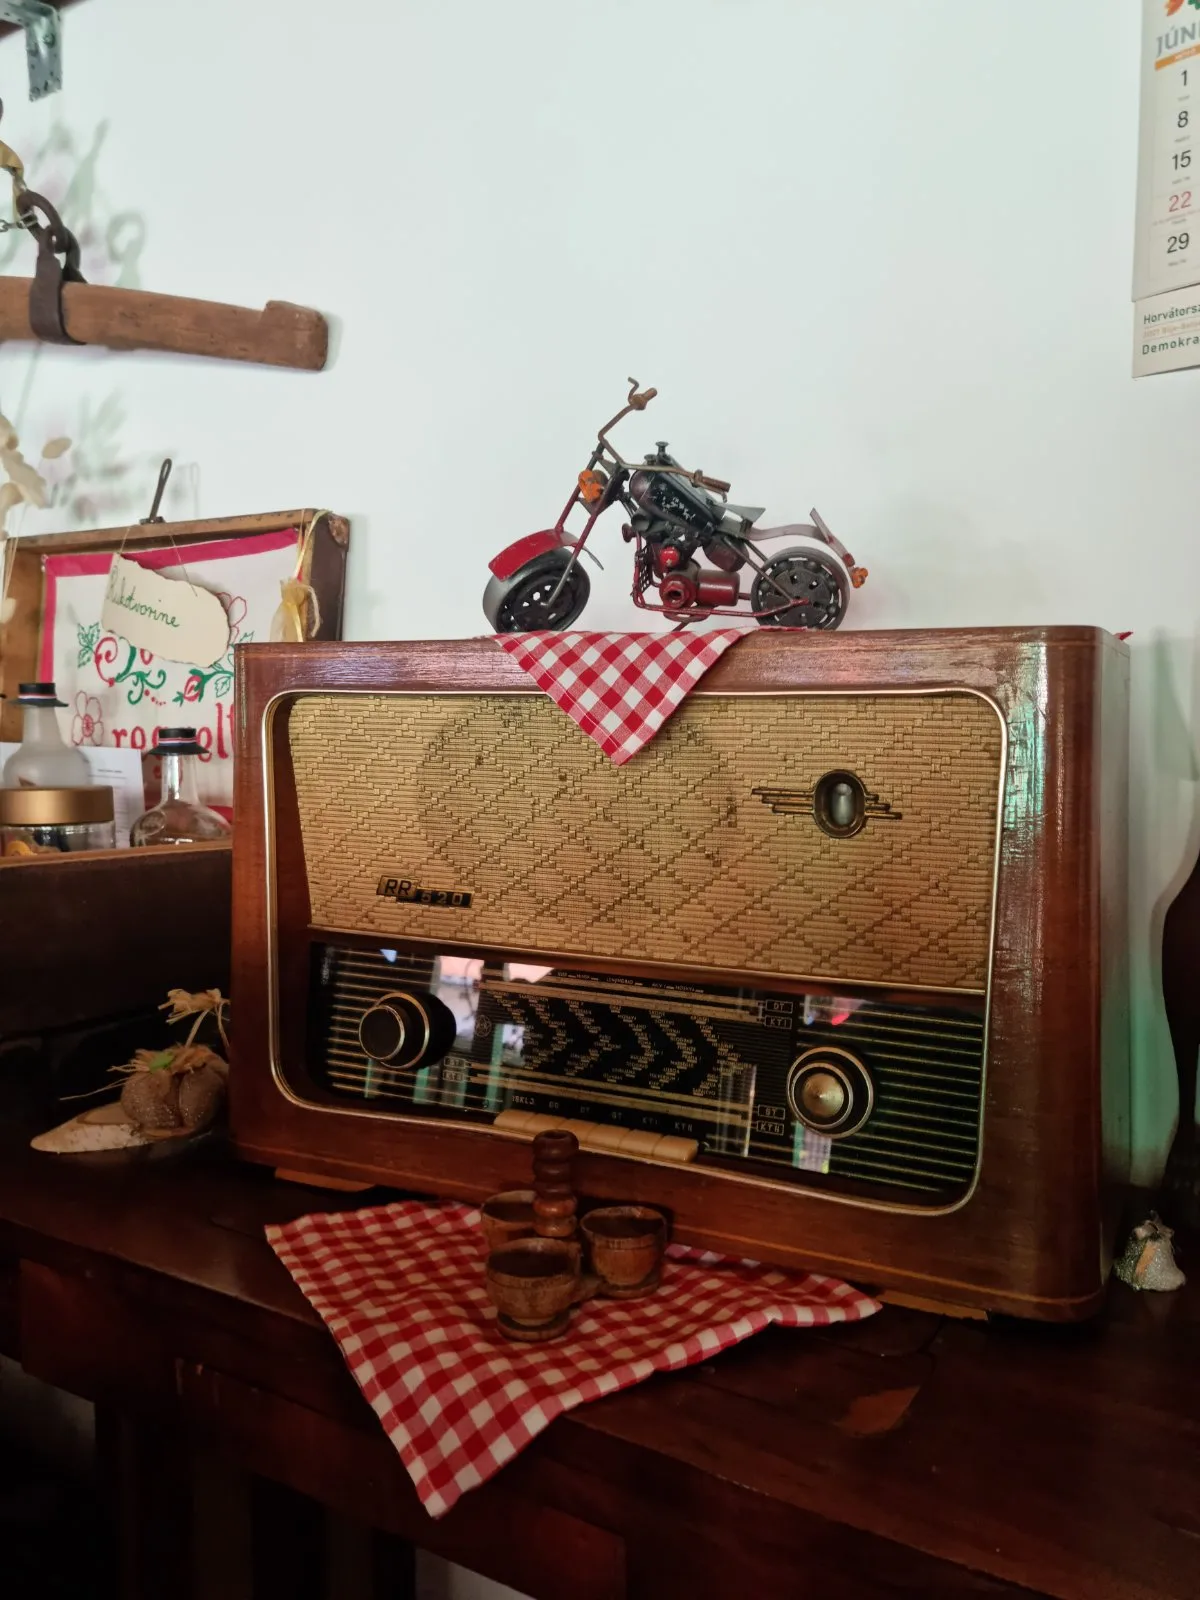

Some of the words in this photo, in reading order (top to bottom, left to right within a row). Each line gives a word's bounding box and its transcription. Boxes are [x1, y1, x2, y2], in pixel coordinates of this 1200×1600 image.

[1181, 70, 1188, 86] 1
[1177, 110, 1189, 128] 8
[1171, 150, 1191, 170] 15
[1168, 191, 1192, 212] 22
[1167, 232, 1190, 253] 29
